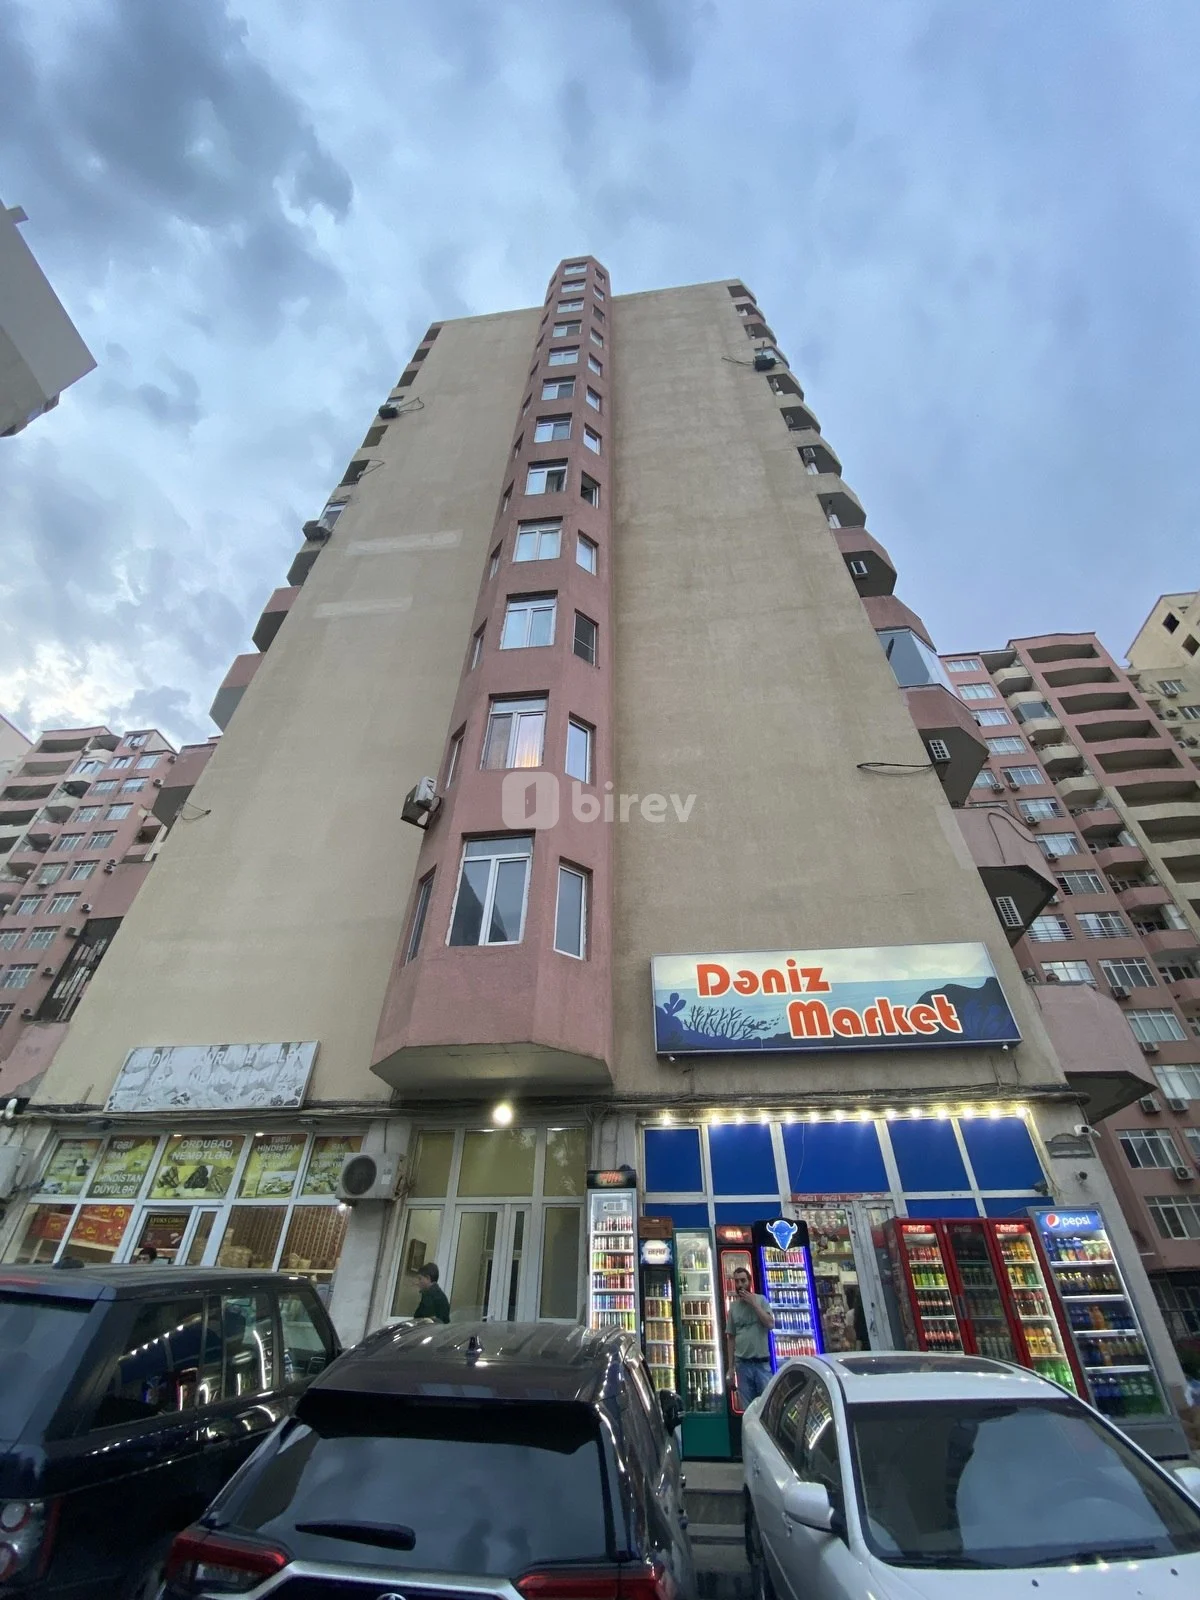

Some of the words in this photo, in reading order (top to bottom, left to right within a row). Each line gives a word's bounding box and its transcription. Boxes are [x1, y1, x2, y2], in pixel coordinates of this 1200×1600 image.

[696, 958, 832, 998] Dəniz
[785, 993, 964, 1042] Market
[181, 1139, 233, 1149] ORDUBAD
[1062, 1214, 1091, 1228] pepsi
